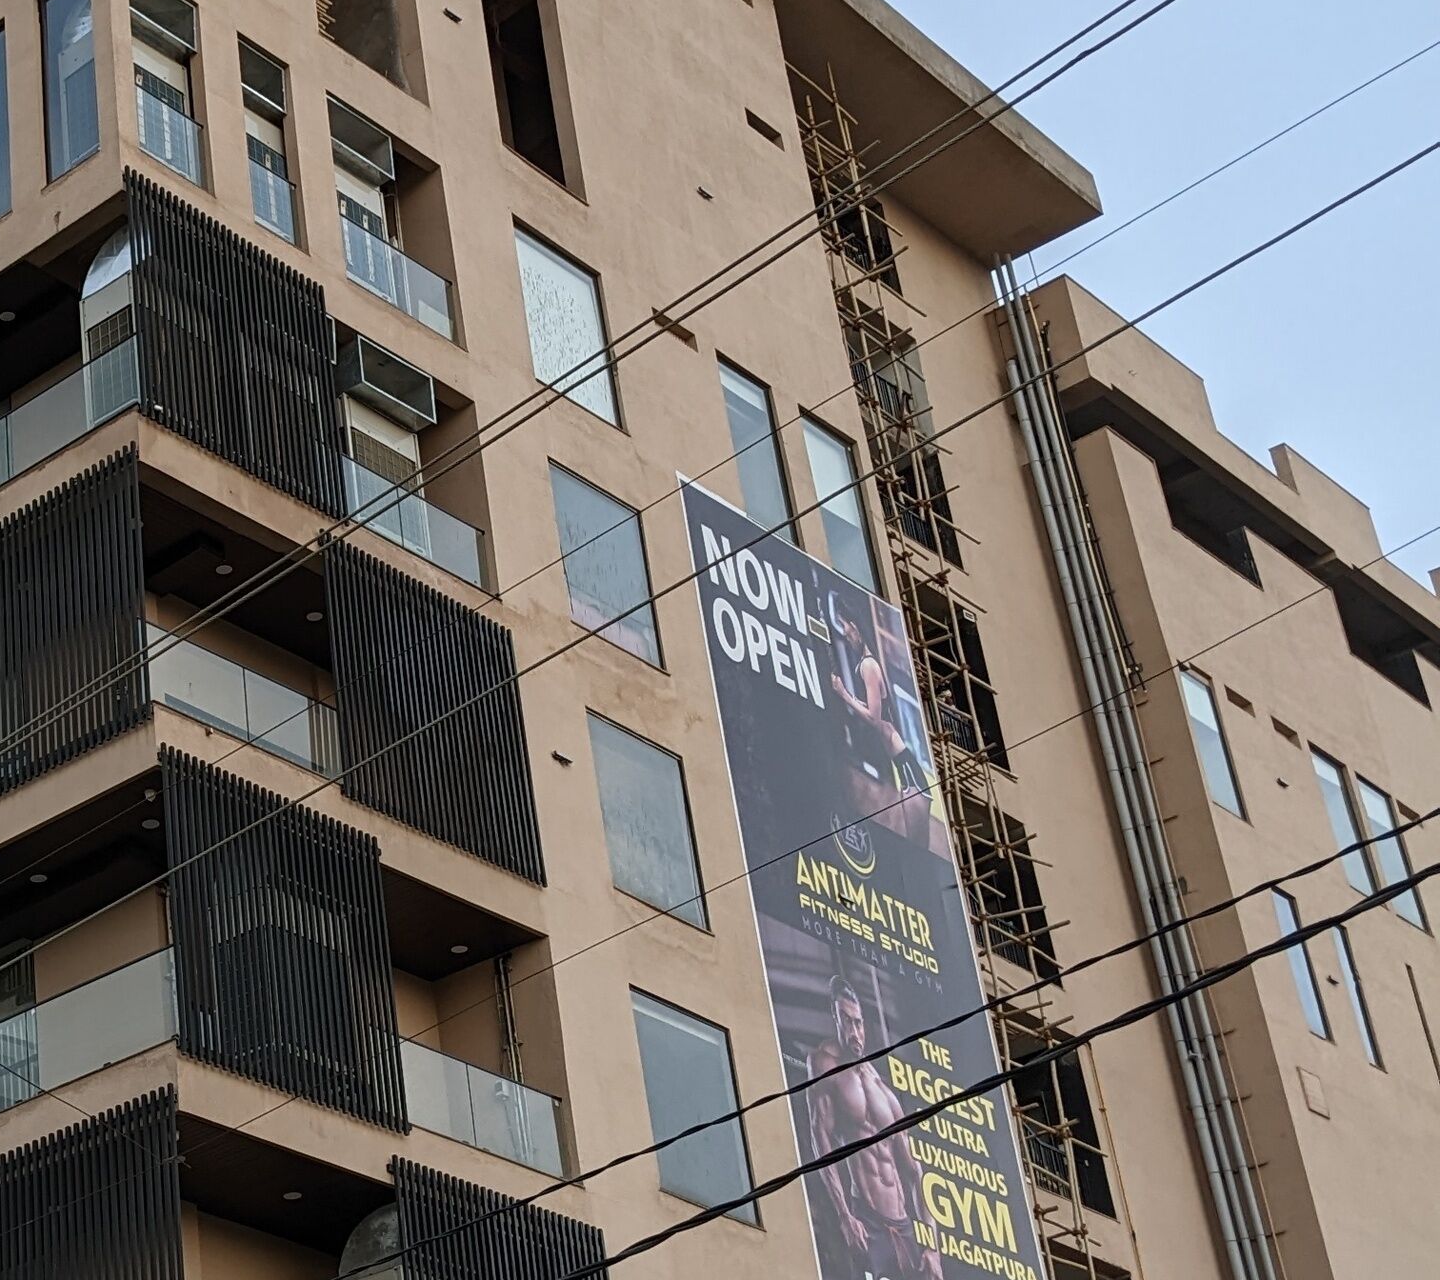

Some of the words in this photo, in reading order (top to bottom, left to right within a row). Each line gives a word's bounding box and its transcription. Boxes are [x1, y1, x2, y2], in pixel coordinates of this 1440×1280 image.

[701, 523, 808, 636] NOW
[712, 597, 825, 710] OPEN
[797, 851, 934, 951] ANTIMATTER
[799, 893, 875, 943] FITNESS
[879, 932, 939, 974] STUDIO
[802, 916, 842, 946] MORE
[851, 938, 888, 967] THAN
[914, 969, 944, 995] GYM
[888, 1054, 996, 1132] BIGGEST
[919, 1037, 953, 1072] THE
[909, 1135, 1009, 1198] LUXURIOUS
[934, 1114, 990, 1159] ULTRA
[914, 1219, 937, 1251] IN
[922, 1171, 1018, 1255] GYM
